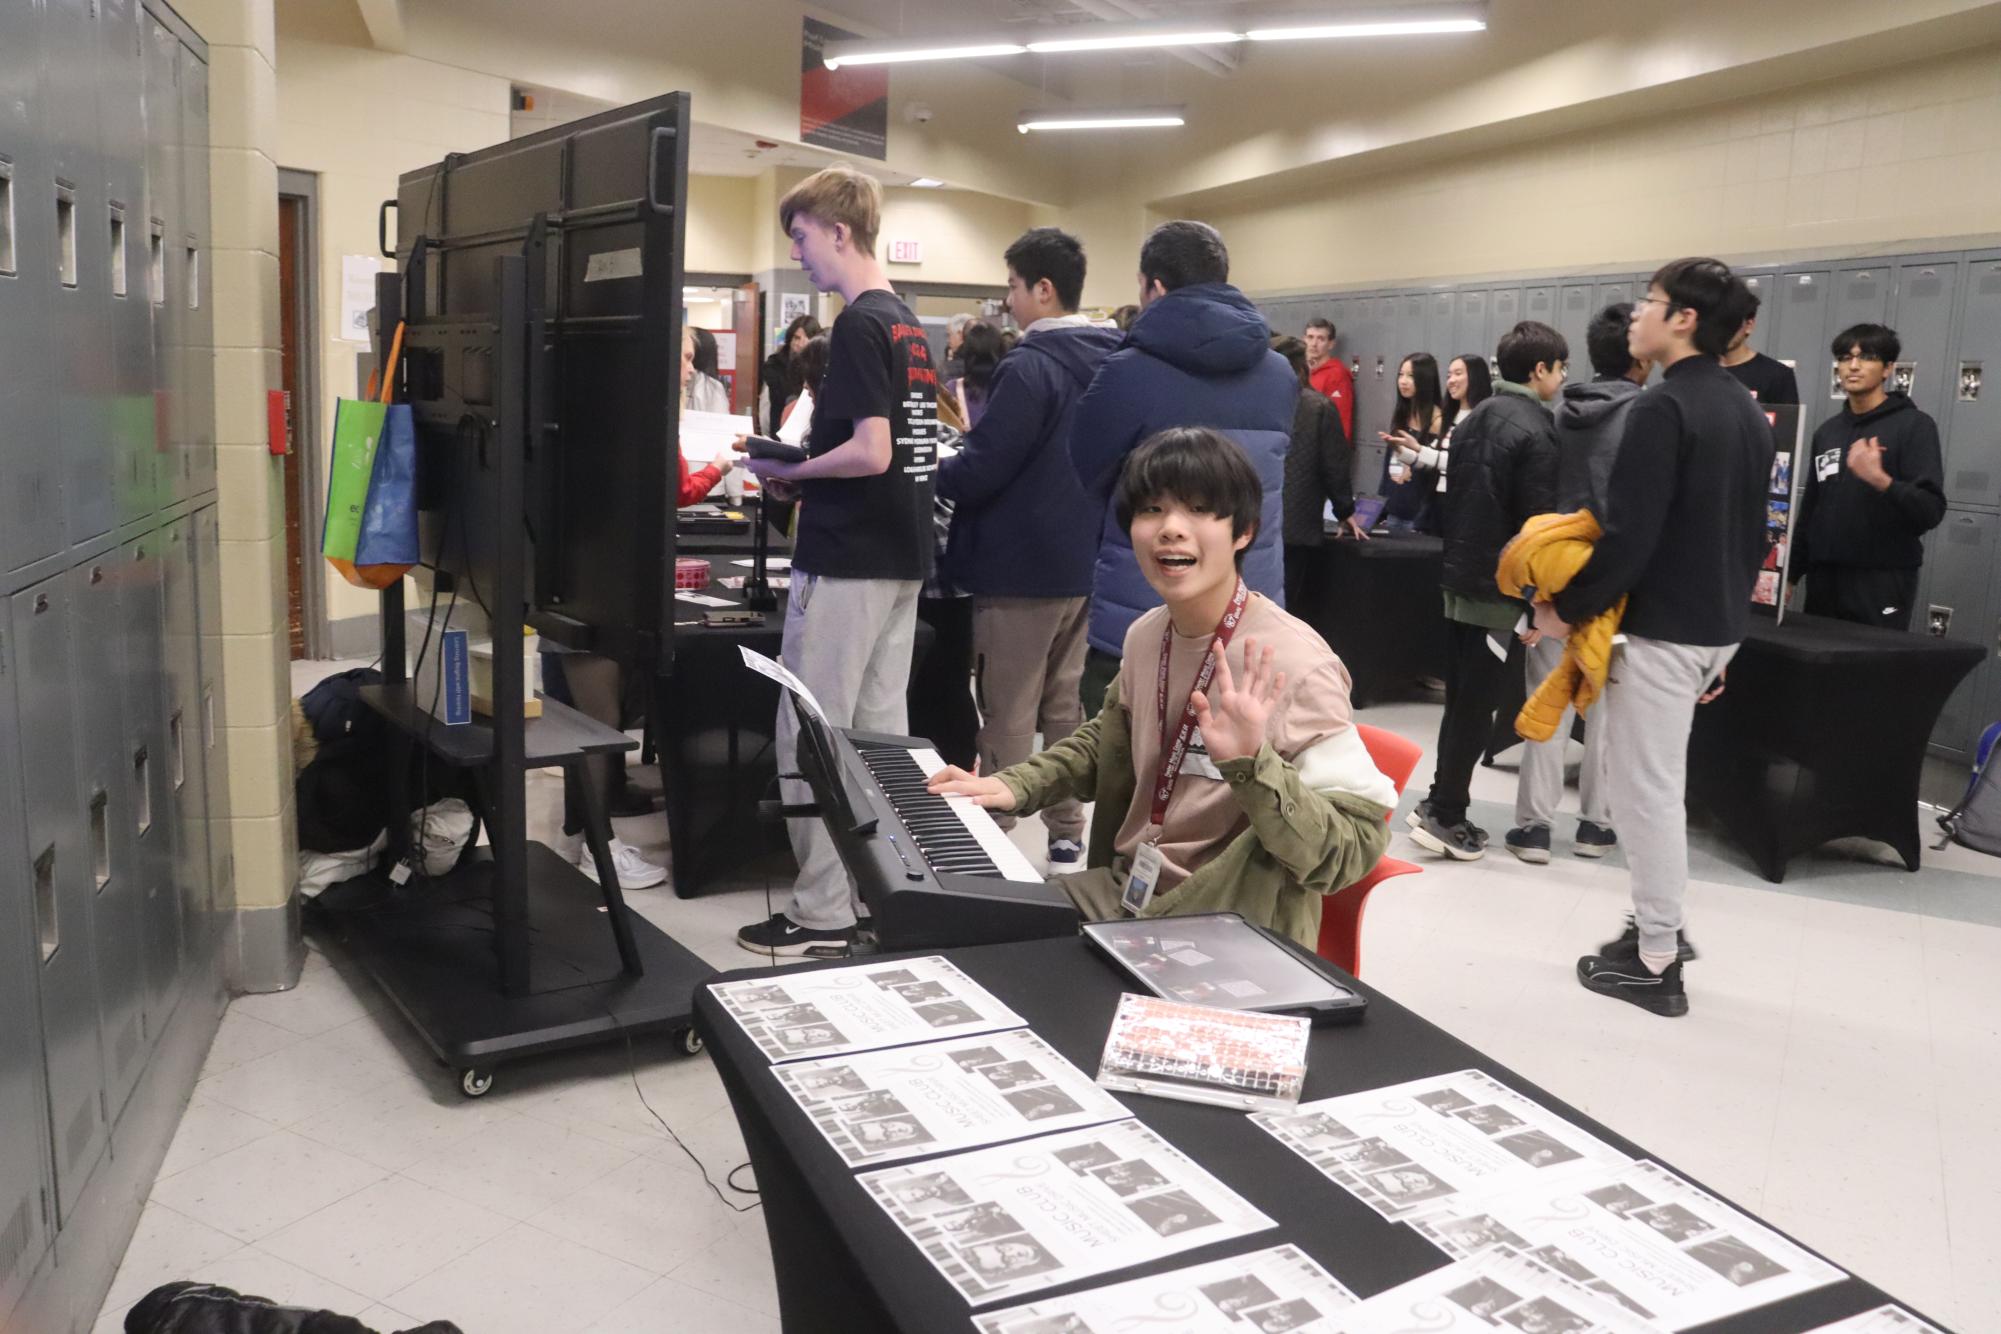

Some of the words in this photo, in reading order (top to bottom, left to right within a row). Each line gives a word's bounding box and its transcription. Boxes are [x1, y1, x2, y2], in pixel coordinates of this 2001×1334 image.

[896, 241, 918, 259] EXIT
[826, 993, 859, 1011] CLUB
[850, 1011, 886, 1032] MUSIC
[905, 1078, 943, 1100] CLUB
[933, 1100, 976, 1127] MUSIC
[1389, 1123, 1437, 1147] CLUB
[1430, 1146, 1488, 1176] MUSIC
[1013, 1185, 1059, 1212] CLUB
[1049, 1212, 1104, 1247] MUSIC
[1563, 1228, 1622, 1258] CLUB
[1614, 1259, 1685, 1296] MUSIC
